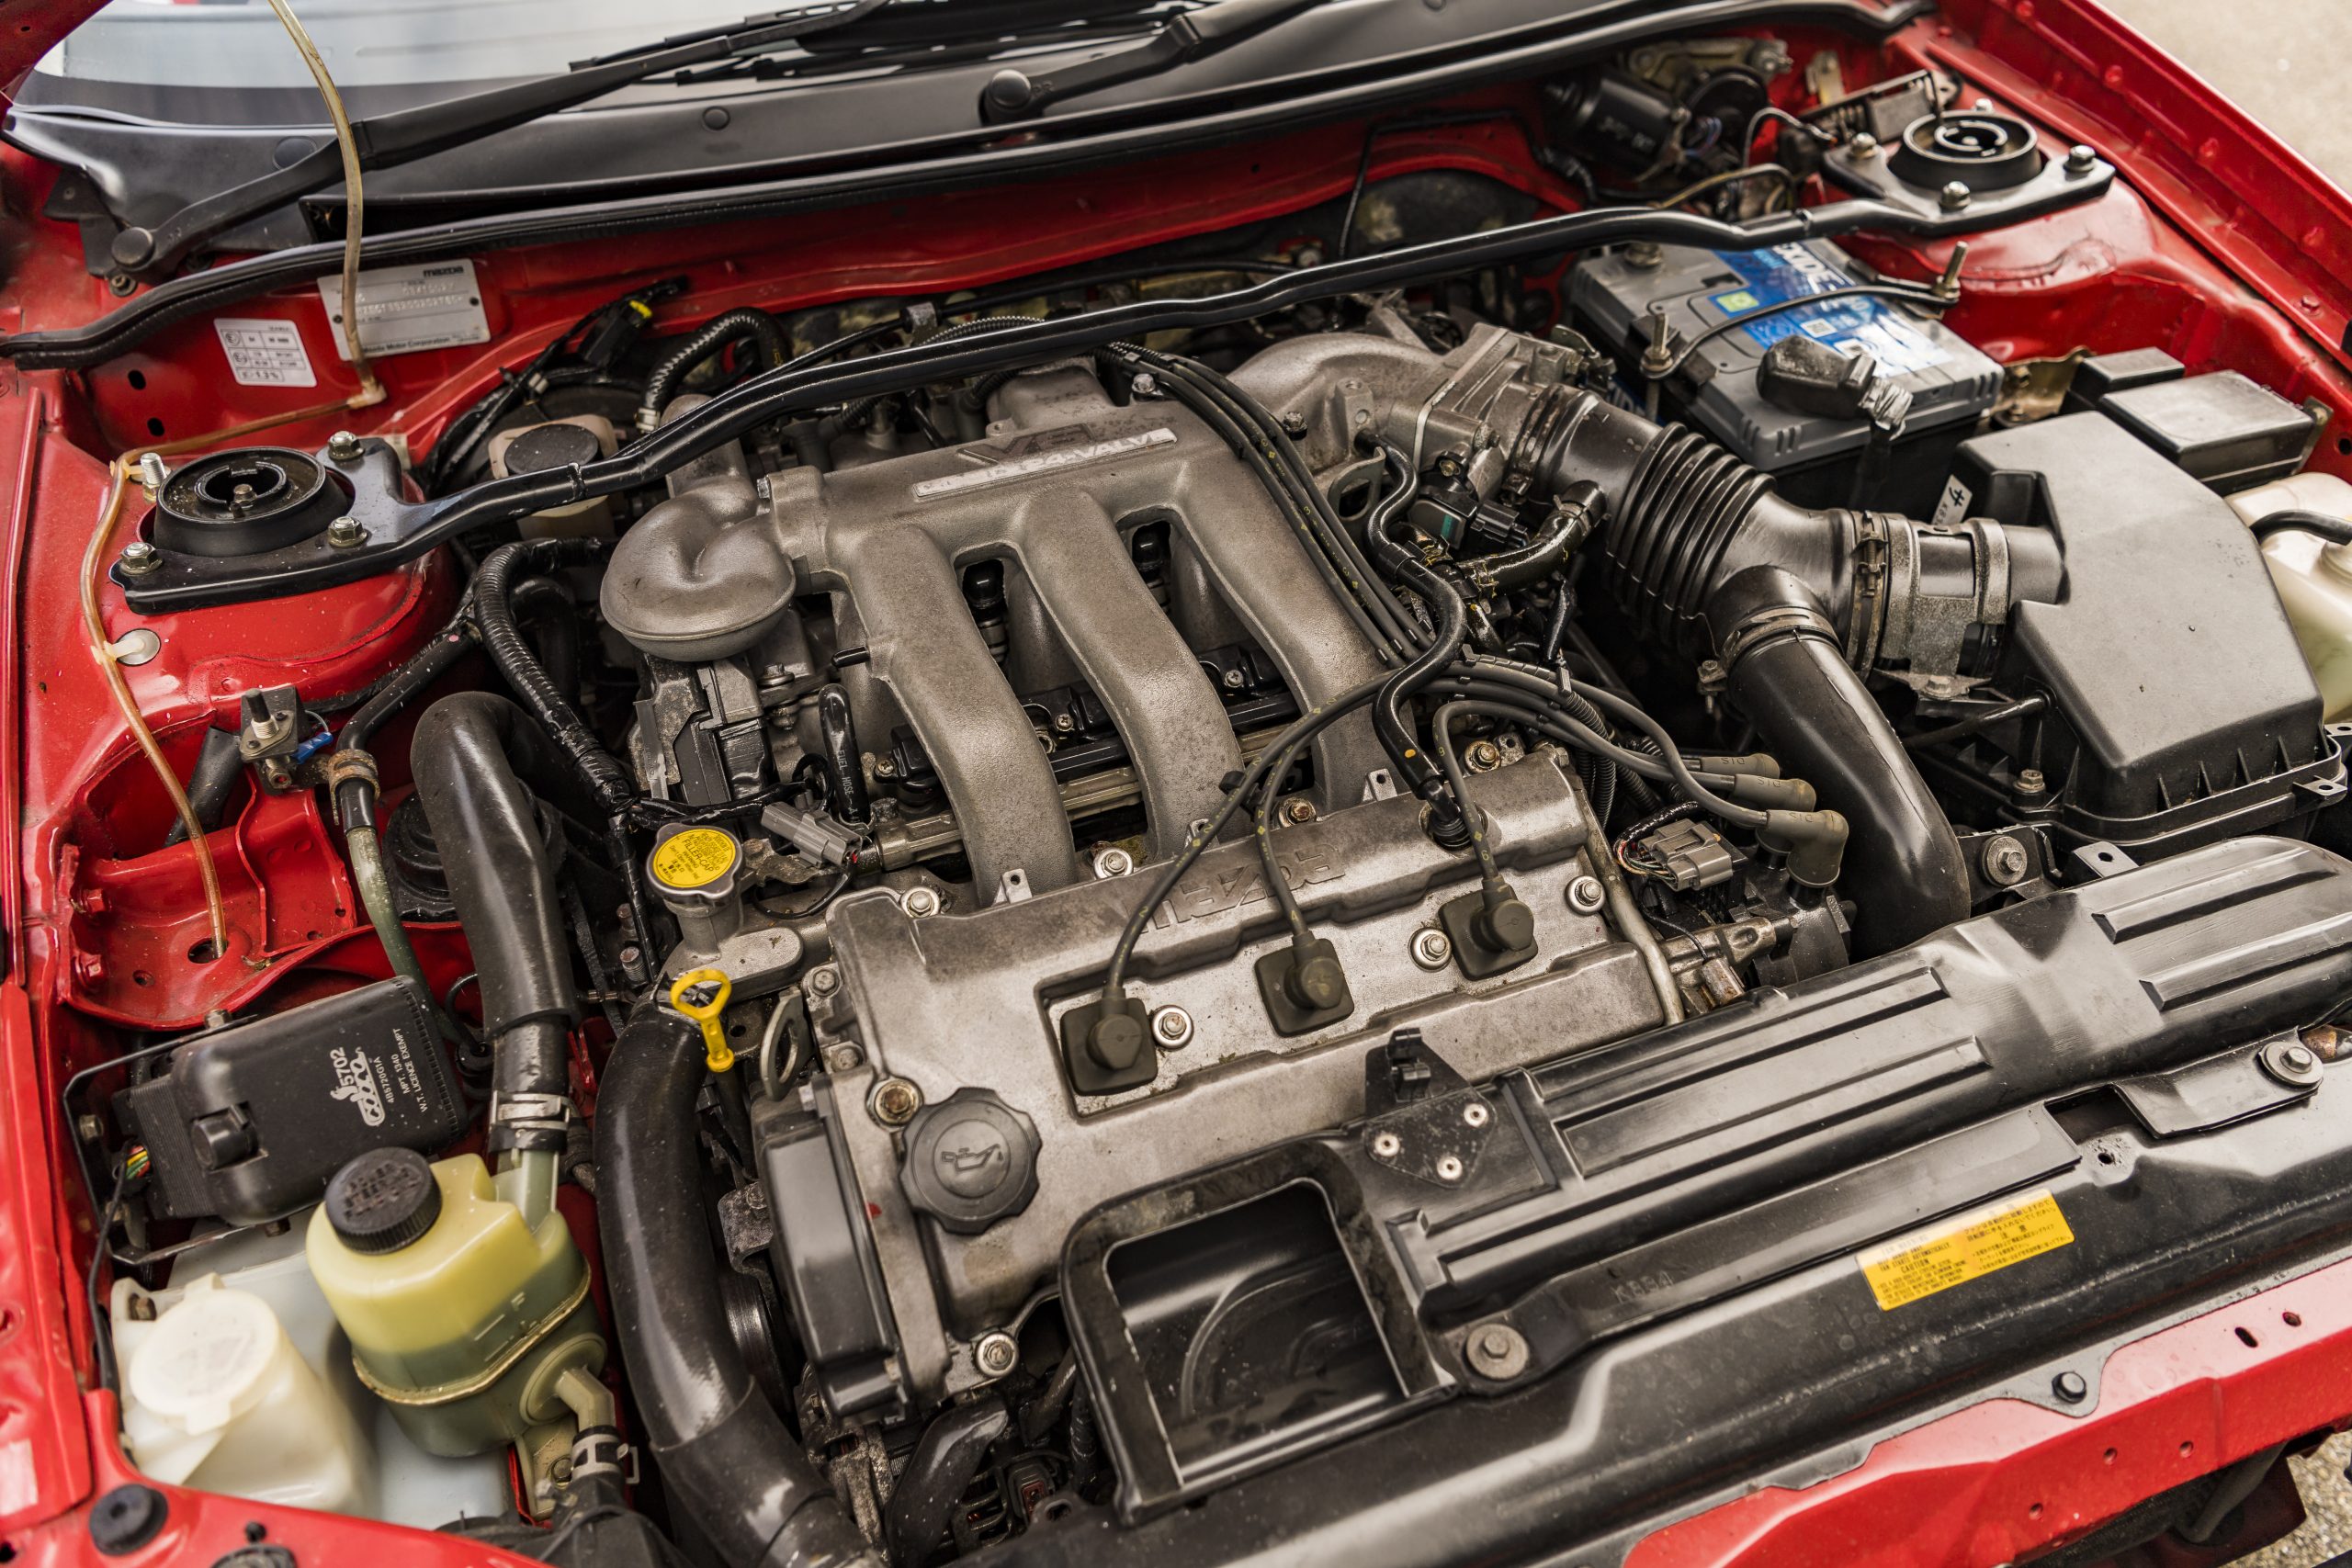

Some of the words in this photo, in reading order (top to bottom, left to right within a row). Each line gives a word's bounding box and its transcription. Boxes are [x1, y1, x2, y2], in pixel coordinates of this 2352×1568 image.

[837, 750, 848, 771] FUEL
[842, 776, 854, 795] HOSE
[681, 838, 713, 873] FILLER-CAP
[392, 1028, 410, 1060] EXEMPT
[329, 1047, 355, 1087] 5702
[390, 1054, 403, 1073] 1340
[405, 1060, 422, 1093] LICENCE
[1899, 1258, 1930, 1273] CAUTION
